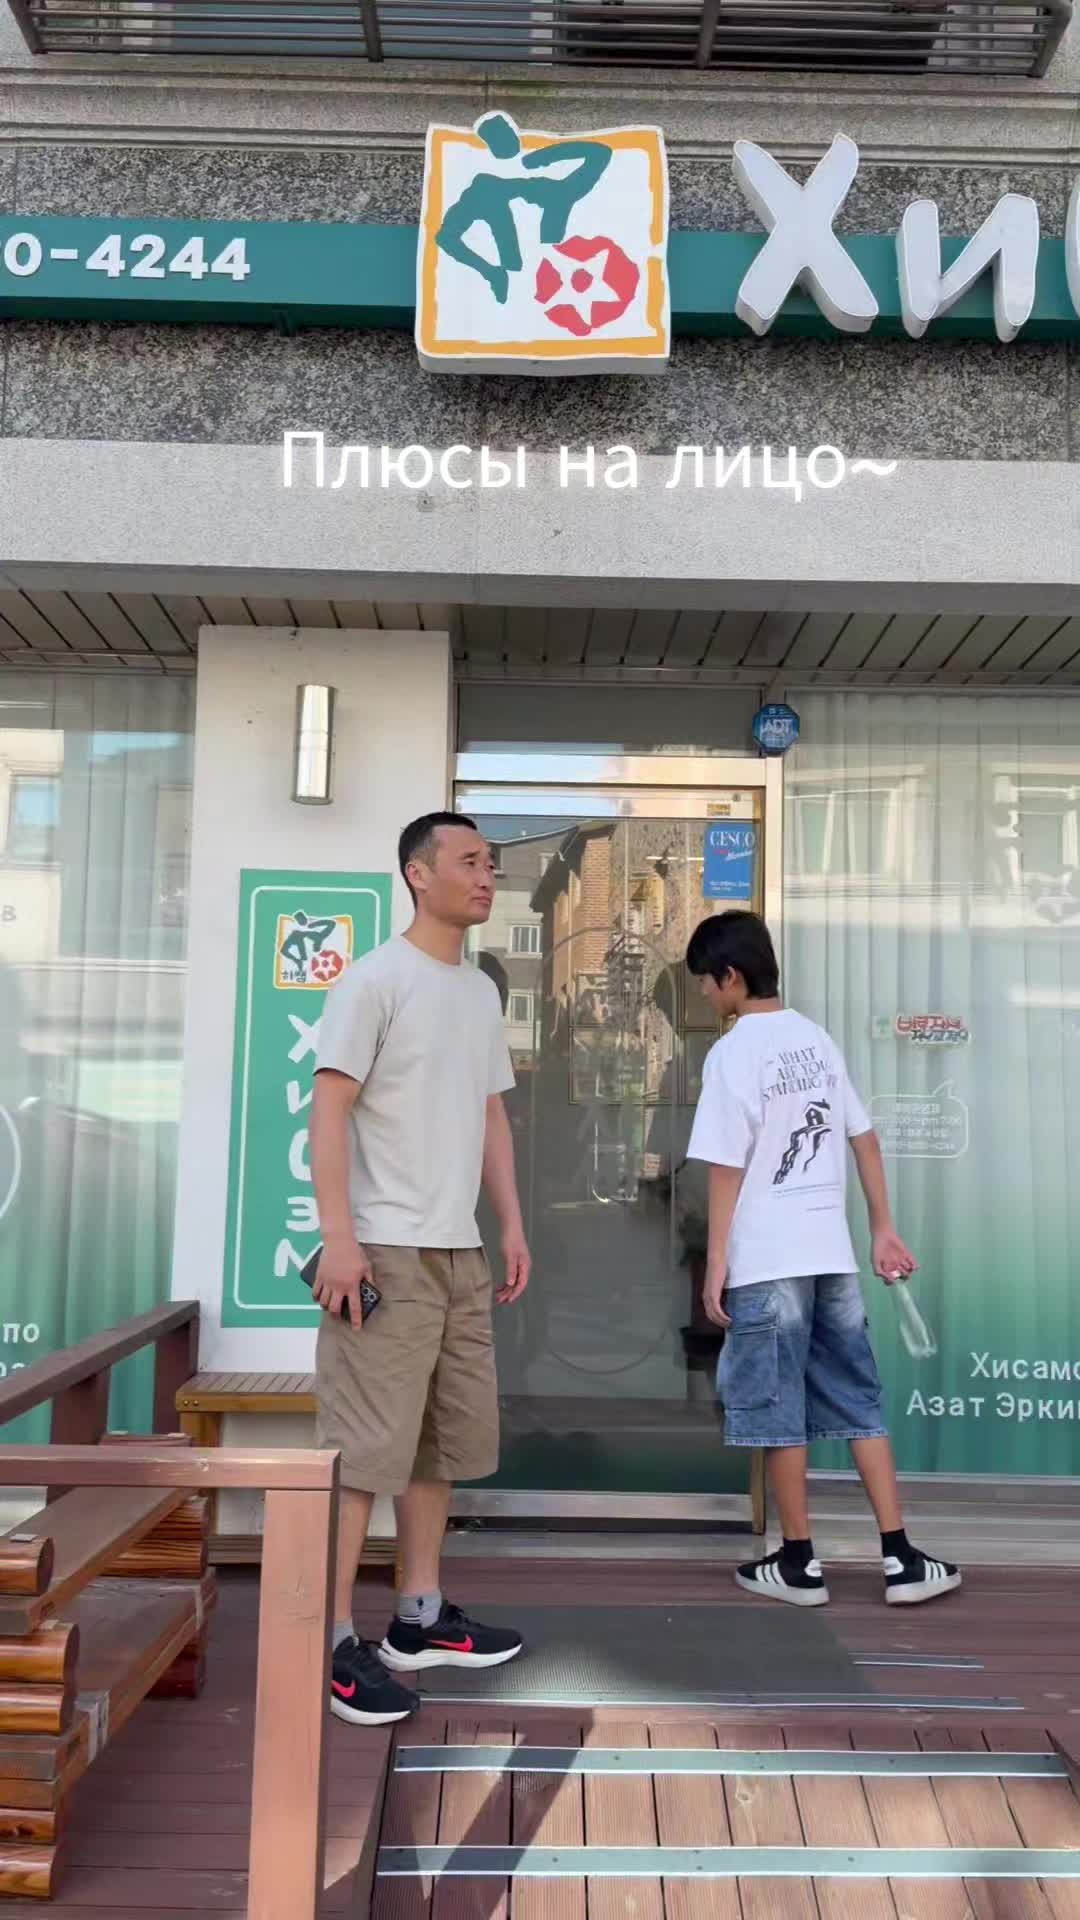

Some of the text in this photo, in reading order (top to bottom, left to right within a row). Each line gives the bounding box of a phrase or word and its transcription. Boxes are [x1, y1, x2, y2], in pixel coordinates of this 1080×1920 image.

[710, 830, 756, 848] CESCO
[906, 1389, 1080, 1422] Азат Эрки
